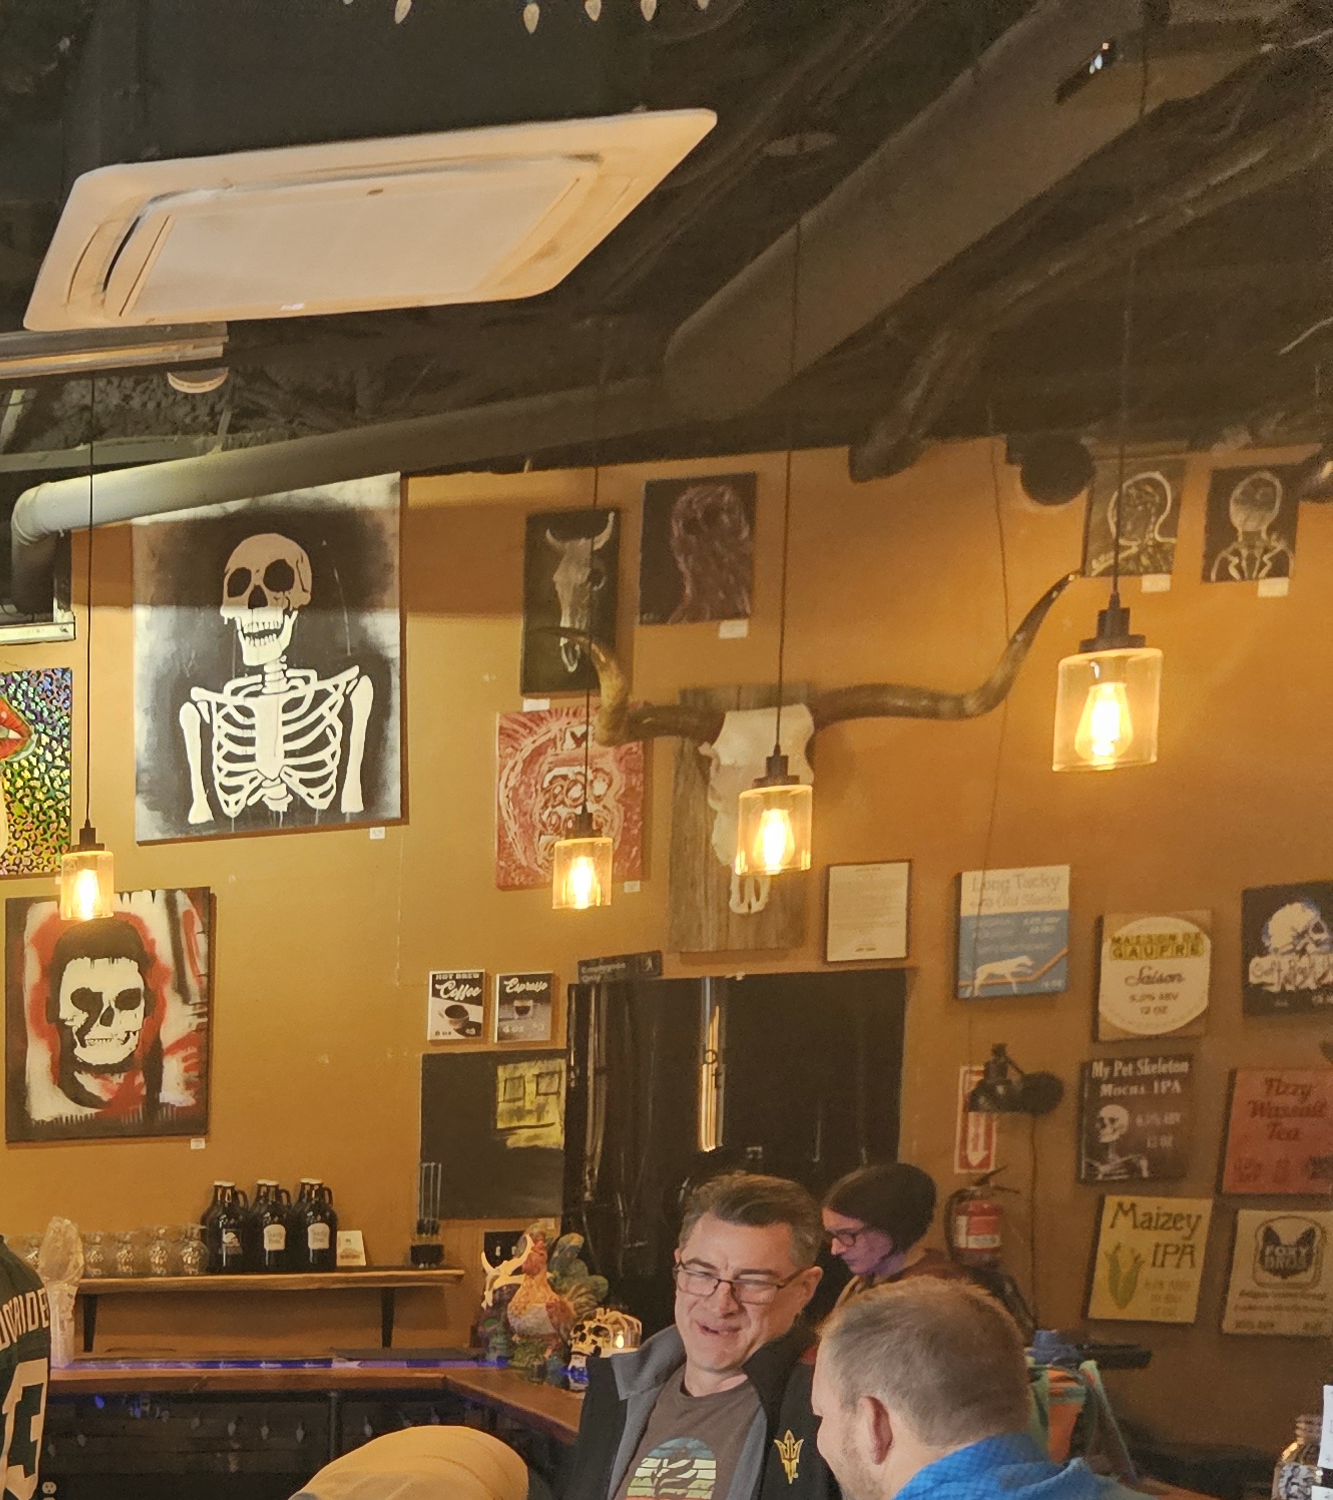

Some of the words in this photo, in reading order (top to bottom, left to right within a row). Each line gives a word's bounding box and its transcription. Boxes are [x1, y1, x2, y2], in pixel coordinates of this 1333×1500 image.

[455, 972, 480, 980] BREW
[503, 977, 549, 994] Espresso
[435, 980, 482, 1001] Coffee
[1092, 1060, 1112, 1081] My
[1113, 1059, 1134, 1077] Pet
[1135, 1057, 1191, 1076] Skeleton
[1153, 1080, 1182, 1095] IPA
[1109, 1201, 1203, 1241] Maizey
[1151, 1242, 1196, 1270] IPA
